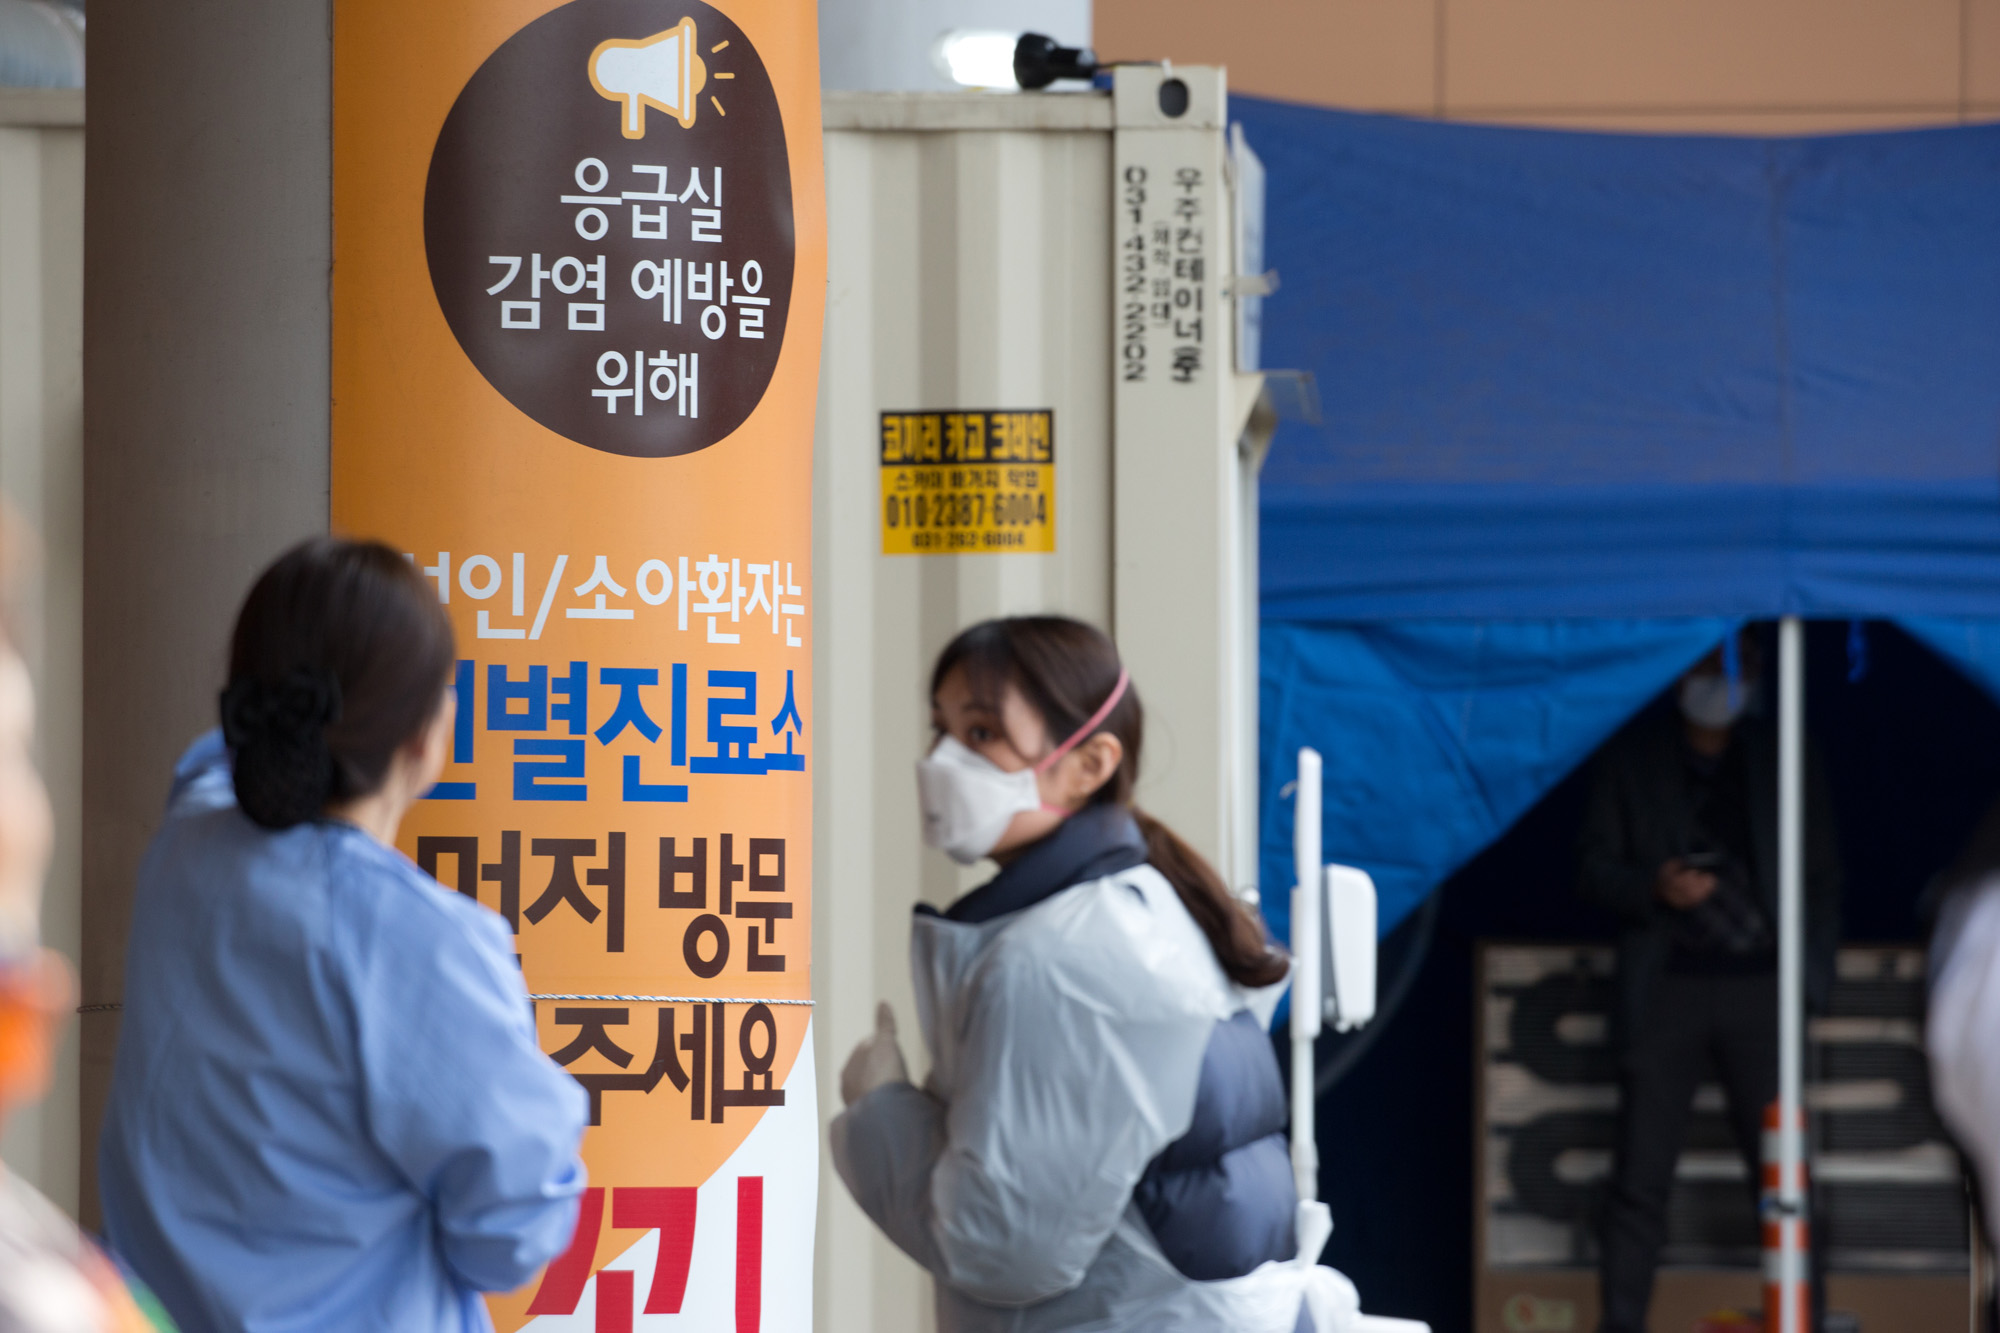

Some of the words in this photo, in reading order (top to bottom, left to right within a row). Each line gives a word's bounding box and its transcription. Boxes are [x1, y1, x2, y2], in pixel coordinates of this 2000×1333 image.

[560, 157, 722, 242] 응급실
[486, 253, 606, 331] 감염
[631, 258, 770, 340] 예방을
[591, 350, 698, 418] 위해
[659, 833, 793, 979] 방문
